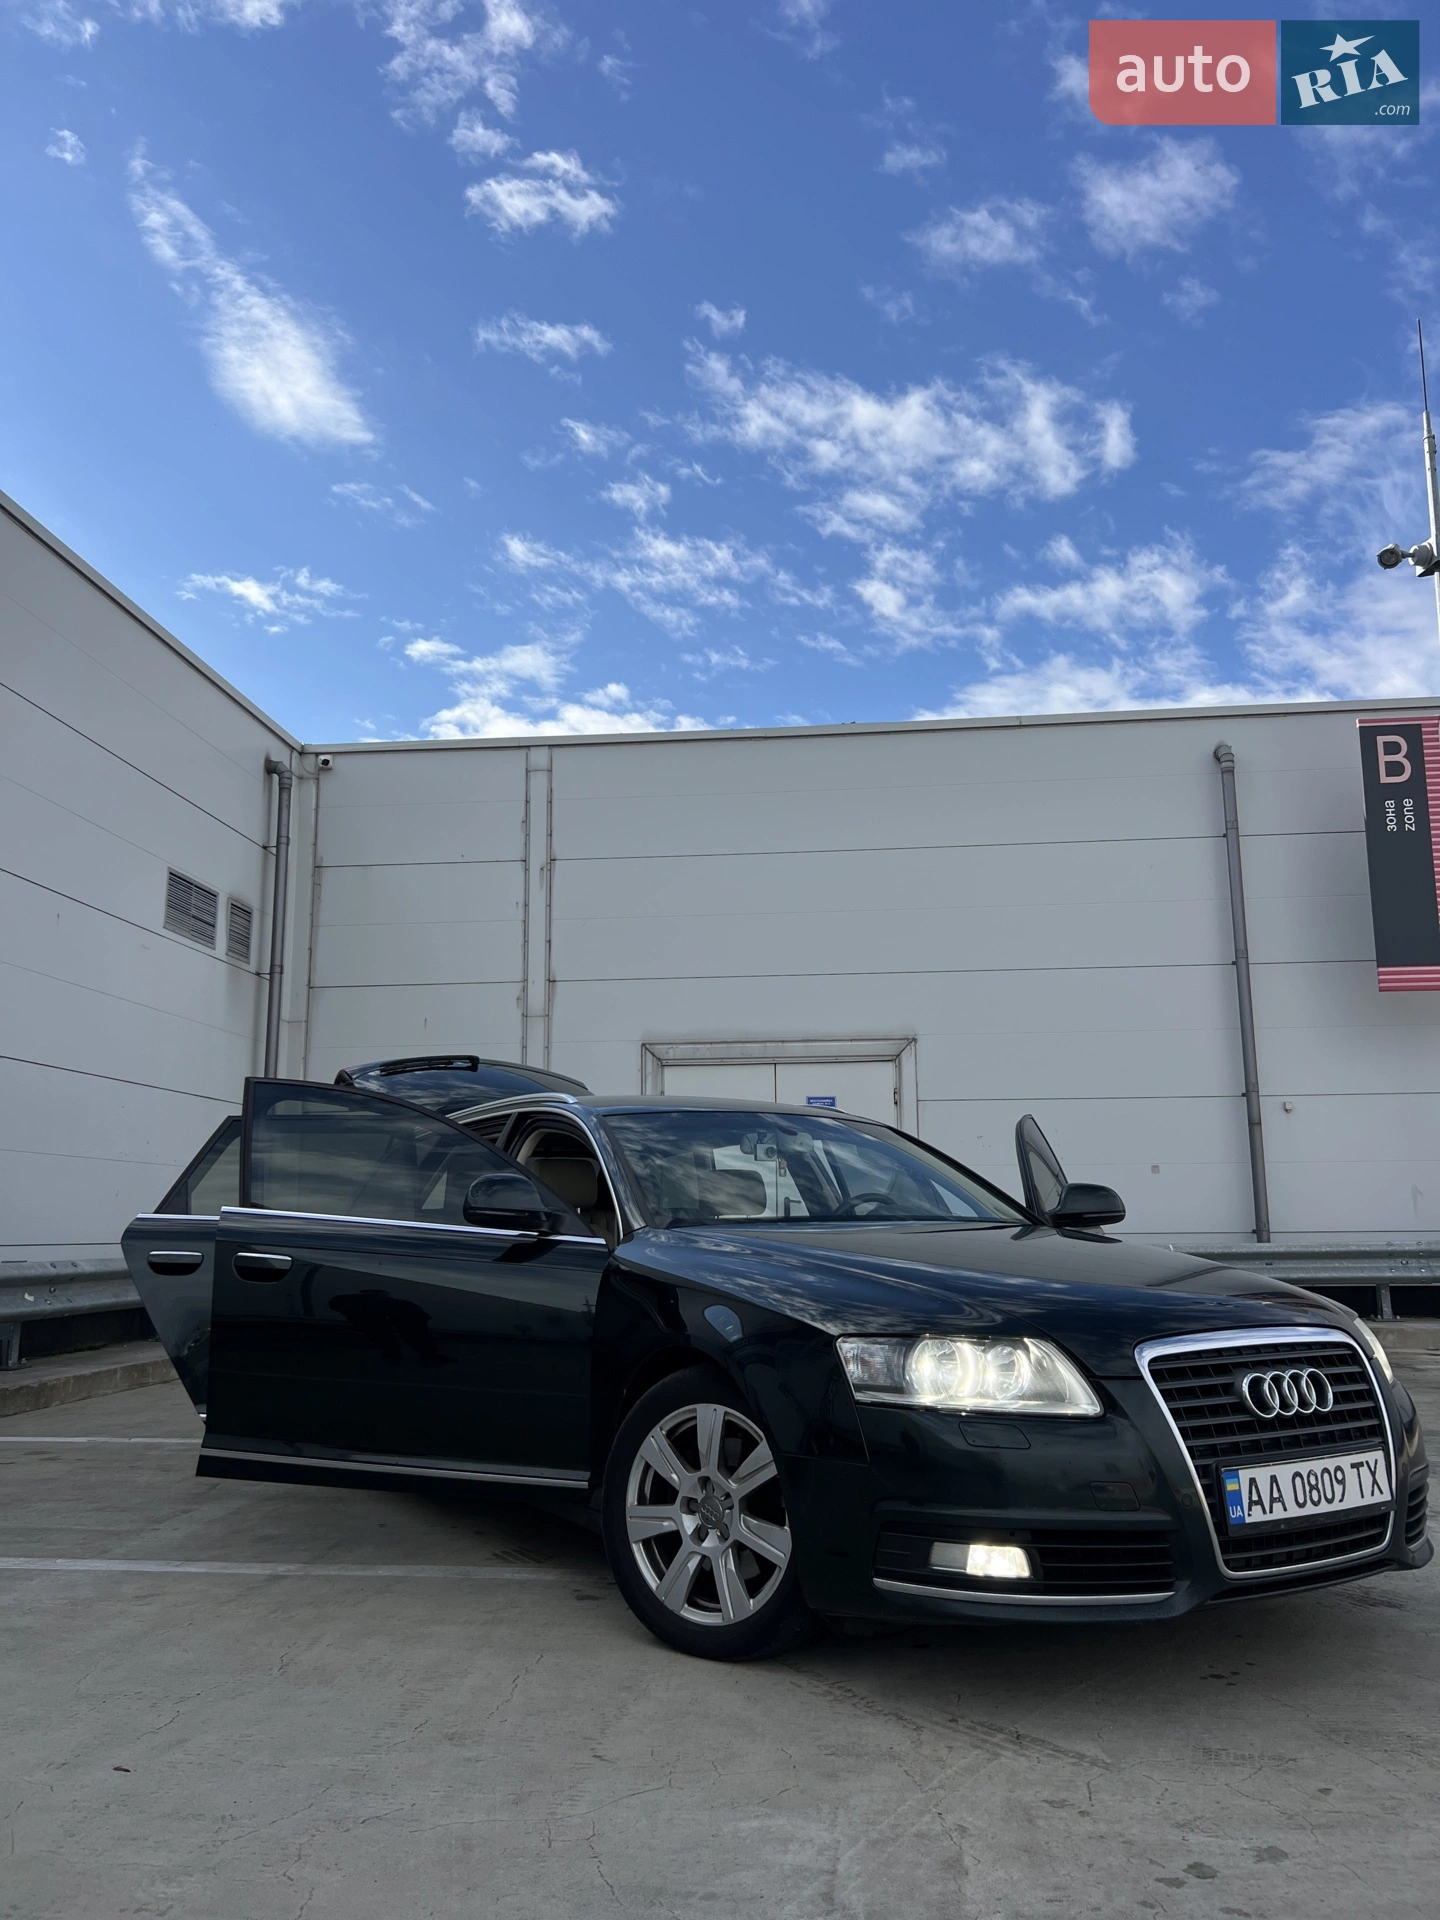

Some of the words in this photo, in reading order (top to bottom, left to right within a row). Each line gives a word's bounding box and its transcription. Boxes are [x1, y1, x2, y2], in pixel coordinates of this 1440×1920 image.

[1376, 735, 1411, 783] B
[1385, 799, 1397, 832] зона
[1403, 798, 1416, 831] zone
[1247, 1474, 1288, 1517] AA
[1291, 1465, 1346, 1508] 0809
[1350, 1459, 1384, 1499] TX
[1229, 1505, 1243, 1518] UA
